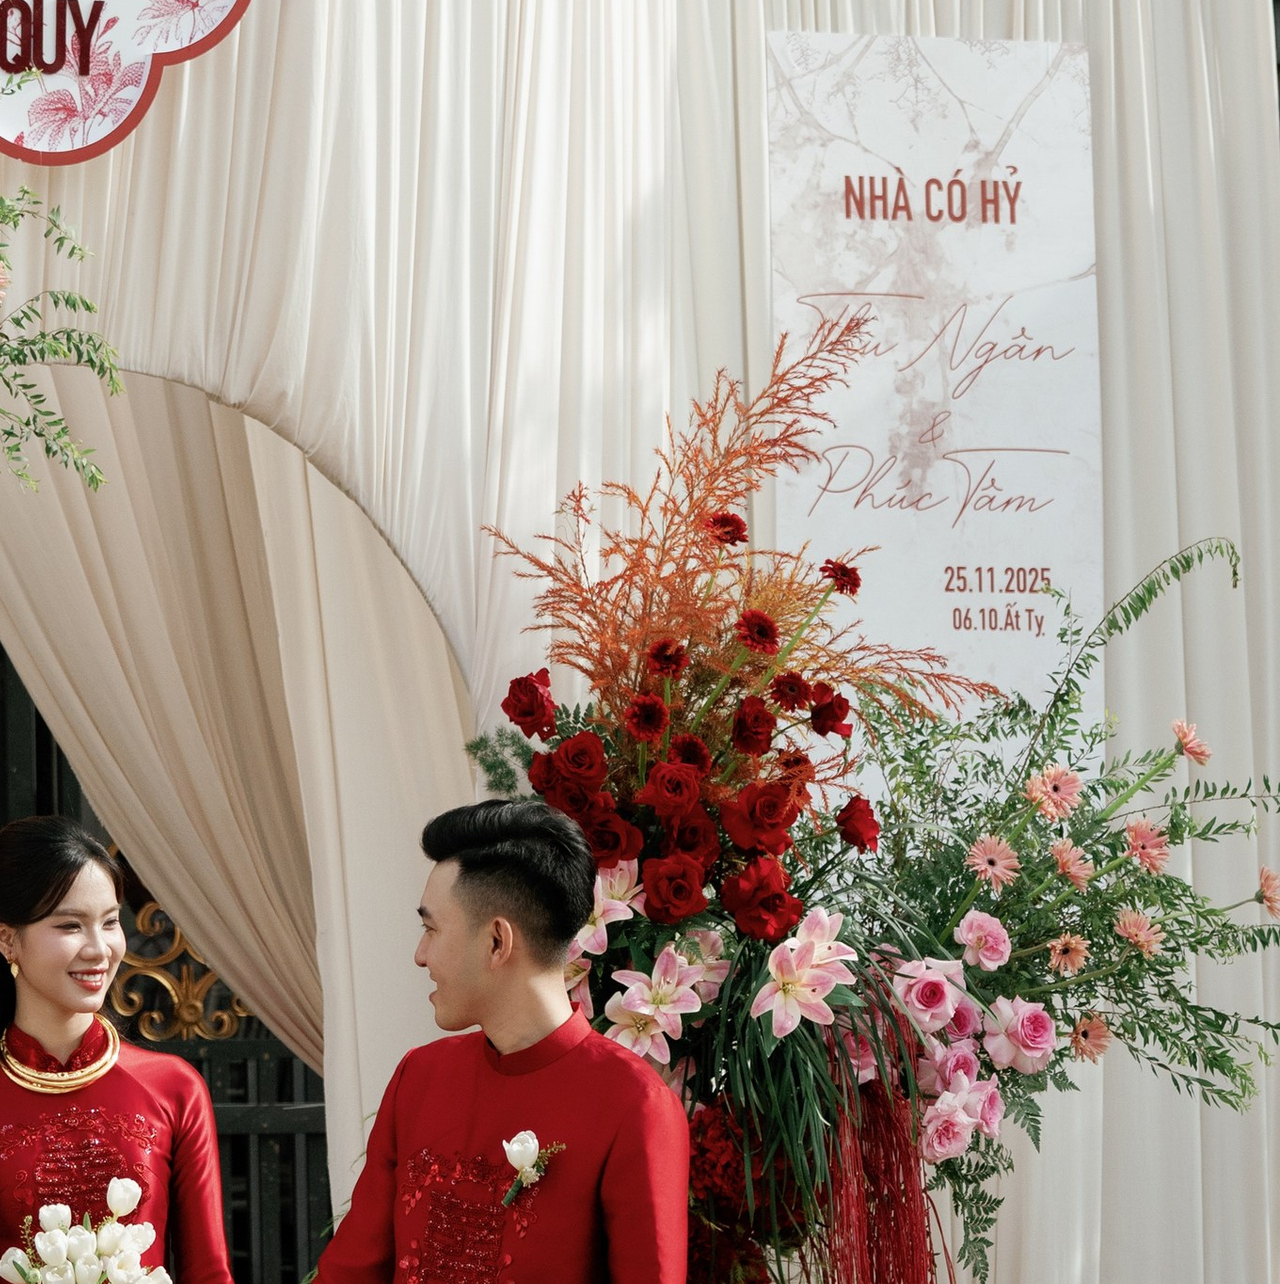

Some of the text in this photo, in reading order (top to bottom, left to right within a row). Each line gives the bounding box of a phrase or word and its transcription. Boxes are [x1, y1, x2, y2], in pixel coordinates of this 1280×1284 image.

[844, 165, 1023, 224] NHÀ CÓ HỶ
[898, 295, 1076, 399] Ngân
[918, 410, 952, 448] &
[807, 445, 1070, 529] Phúc Tâm
[944, 566, 1052, 593] 25.11.2025
